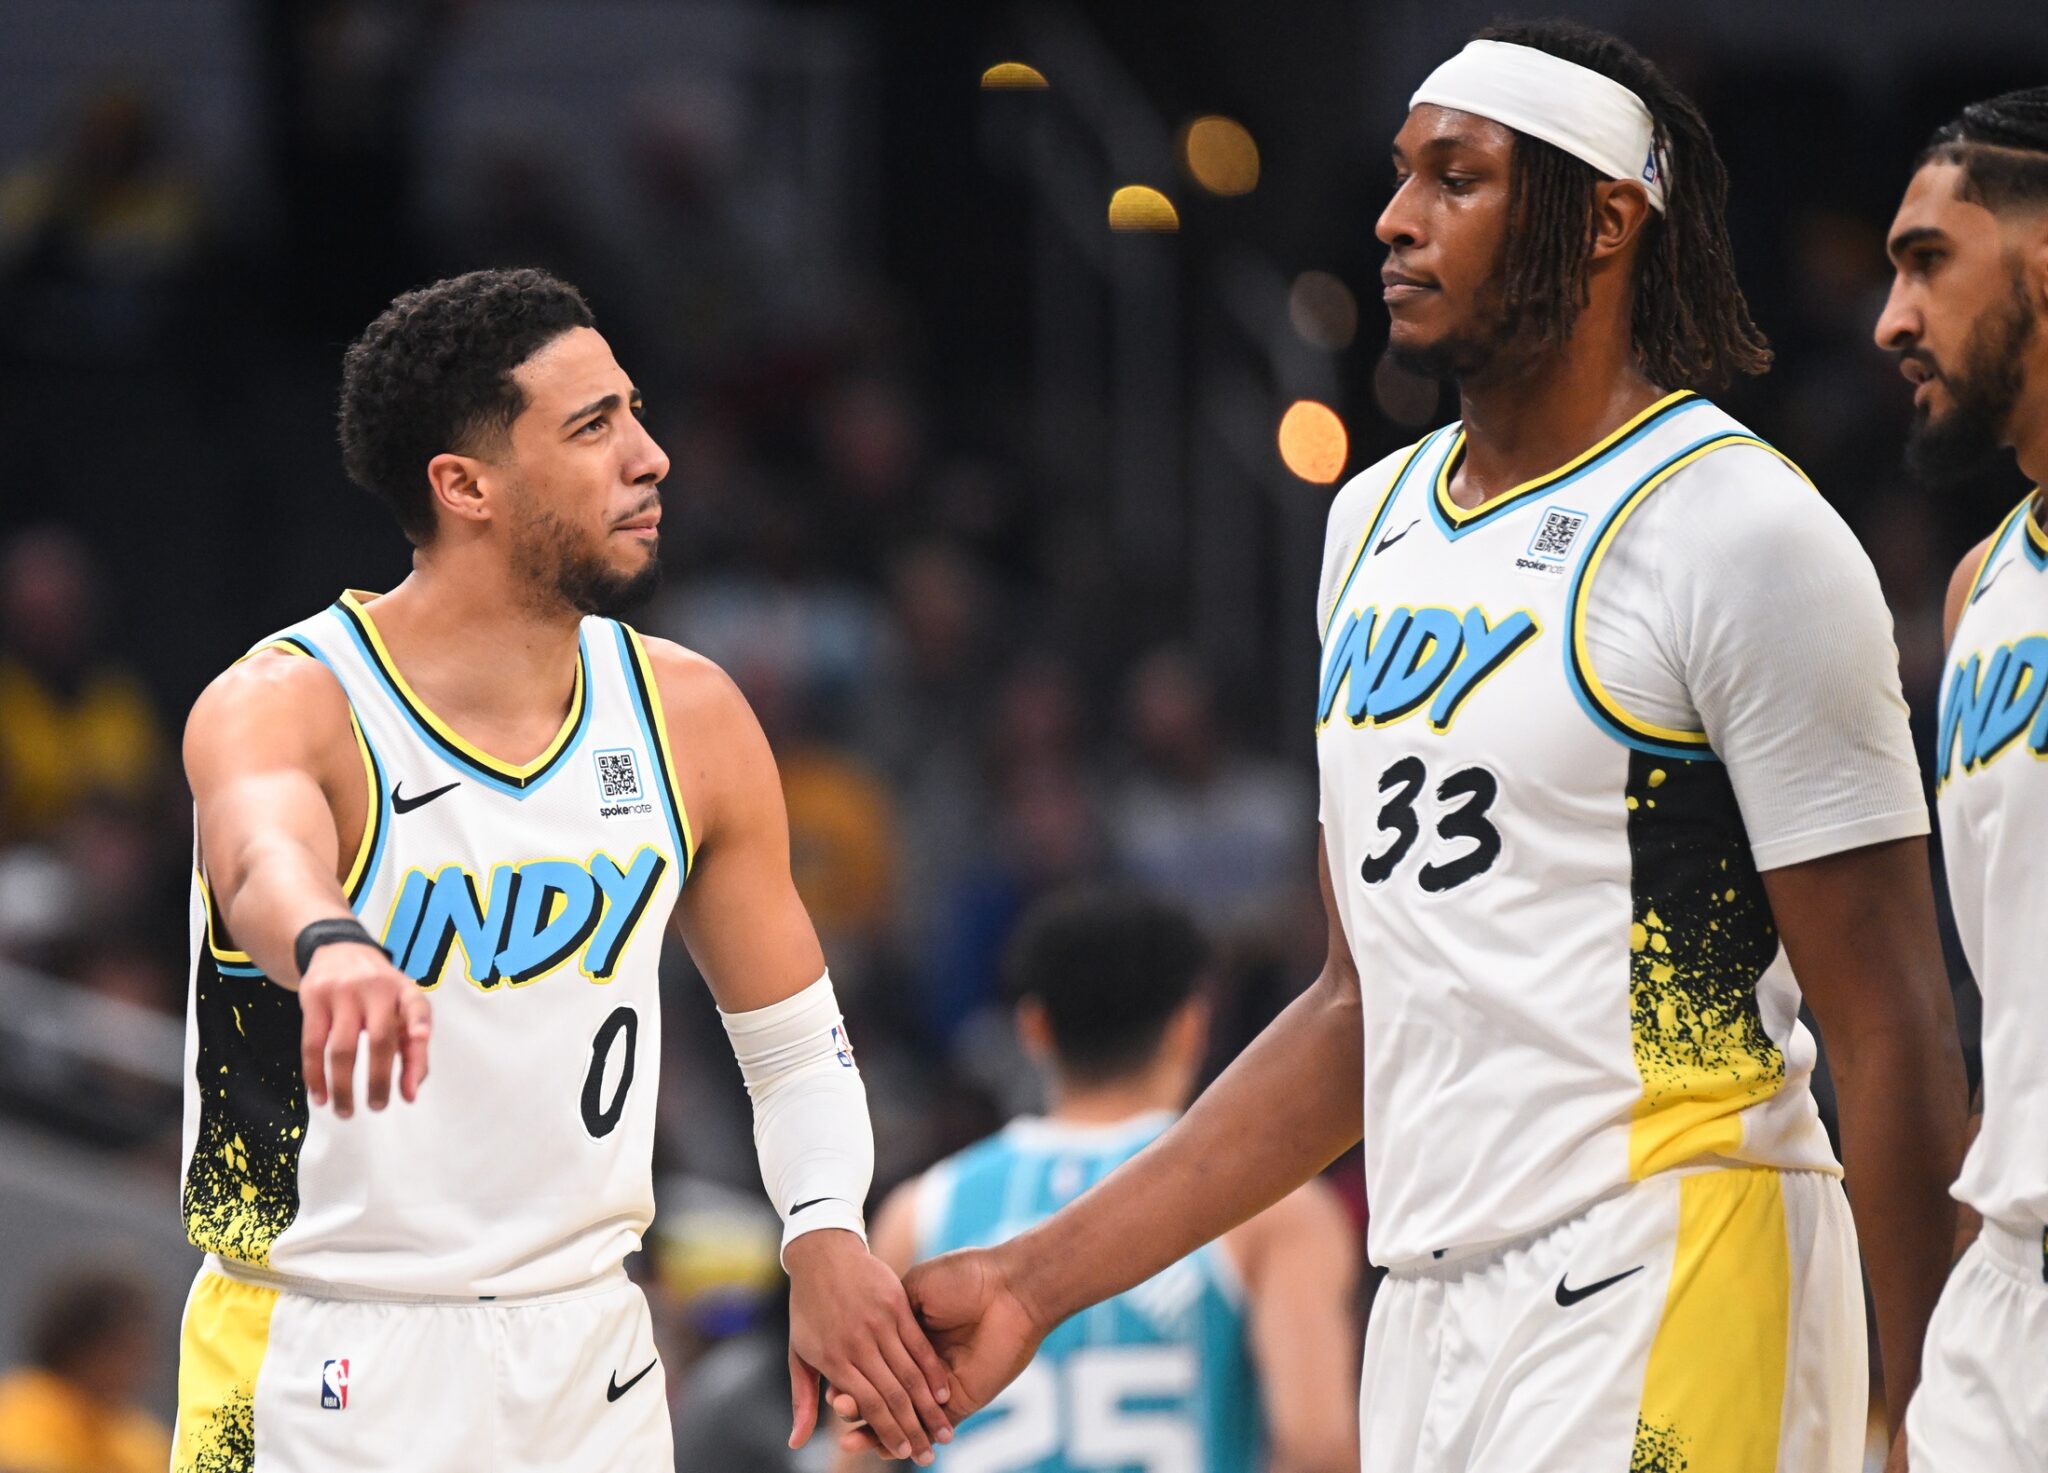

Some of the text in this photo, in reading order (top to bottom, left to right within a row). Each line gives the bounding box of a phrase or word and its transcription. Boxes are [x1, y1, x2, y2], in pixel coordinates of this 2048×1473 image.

[1315, 605, 1540, 735] INDY
[600, 804, 652, 818] spokenote
[1361, 756, 1502, 893] 33
[380, 846, 667, 990] INDY
[580, 1005, 638, 1139] 0
